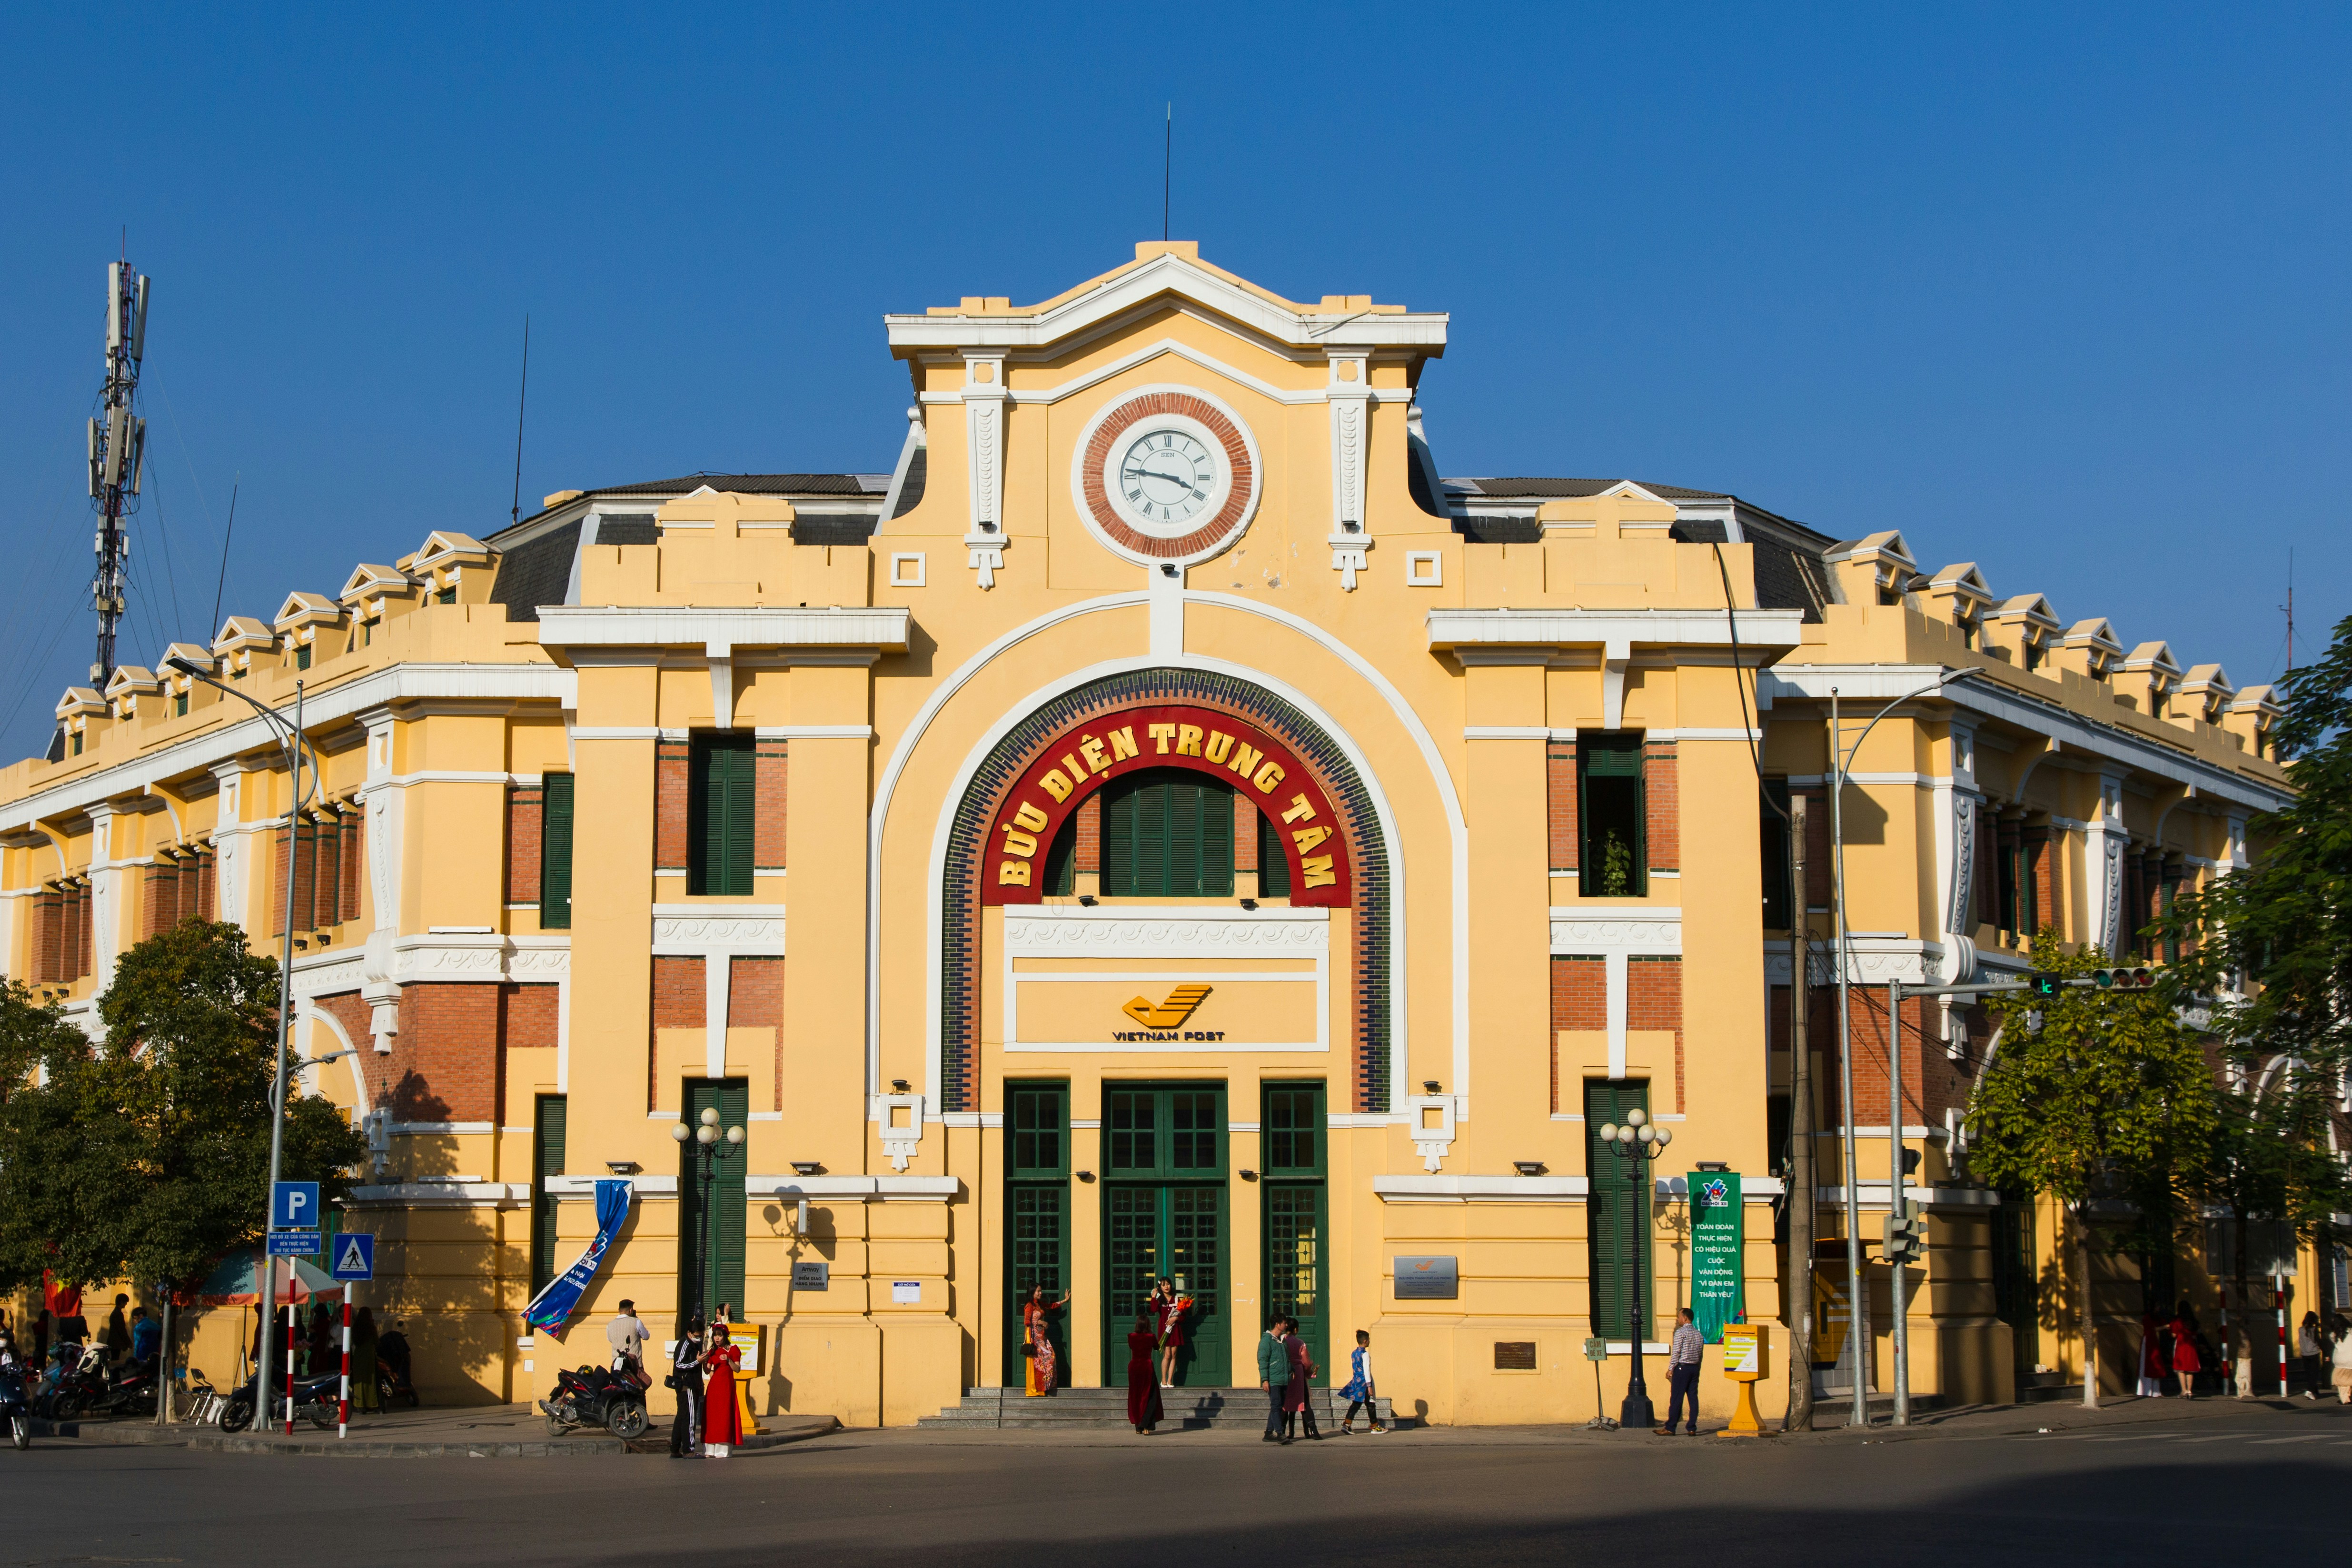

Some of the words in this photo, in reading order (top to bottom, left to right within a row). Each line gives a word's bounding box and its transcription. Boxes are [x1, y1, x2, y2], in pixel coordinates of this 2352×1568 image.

[999, 801, 1048, 886] BƯU
[1038, 725, 1140, 804] ĐIỆN
[1149, 723, 1286, 794] TRUNG
[1280, 793, 1336, 889] TÂM
[1112, 1032, 1179, 1041] VIETNAM
[1184, 1032, 1225, 1041] POST
[288, 1191, 307, 1219] P
